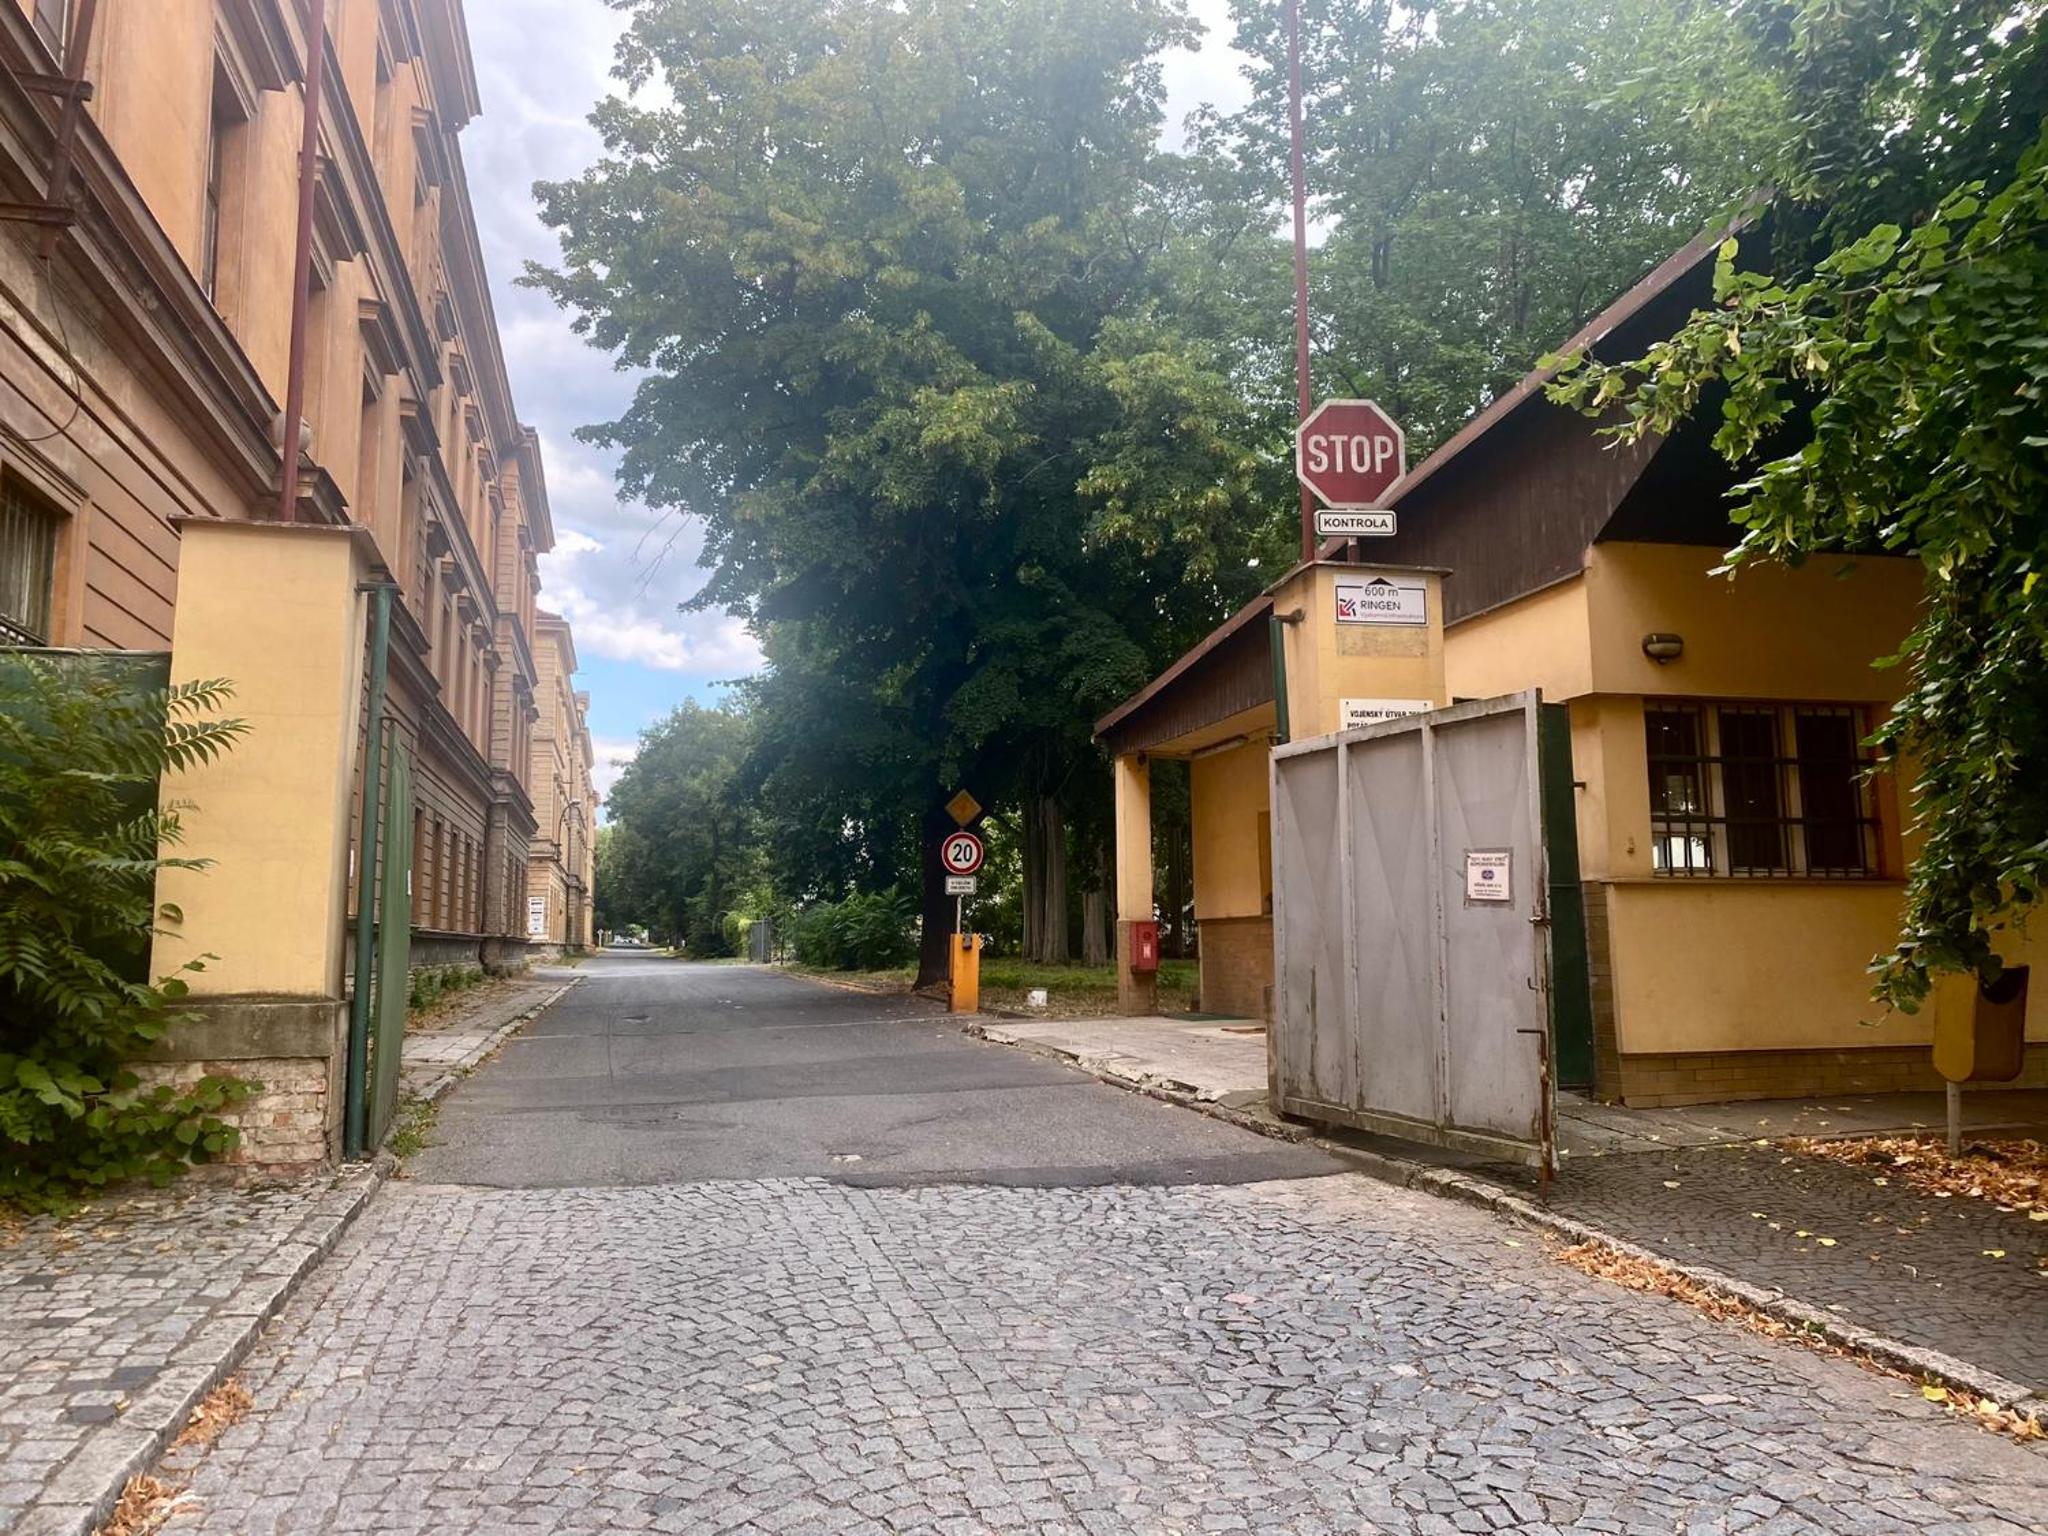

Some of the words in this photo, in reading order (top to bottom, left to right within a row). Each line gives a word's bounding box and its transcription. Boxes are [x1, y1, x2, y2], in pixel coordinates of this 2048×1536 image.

[1308, 434, 1394, 473] STOP
[1324, 518, 1388, 528] KONTROLA
[1365, 586, 1385, 597] 600
[1388, 588, 1399, 597] m
[1360, 600, 1401, 611] RINGEN
[953, 843, 973, 862] 20
